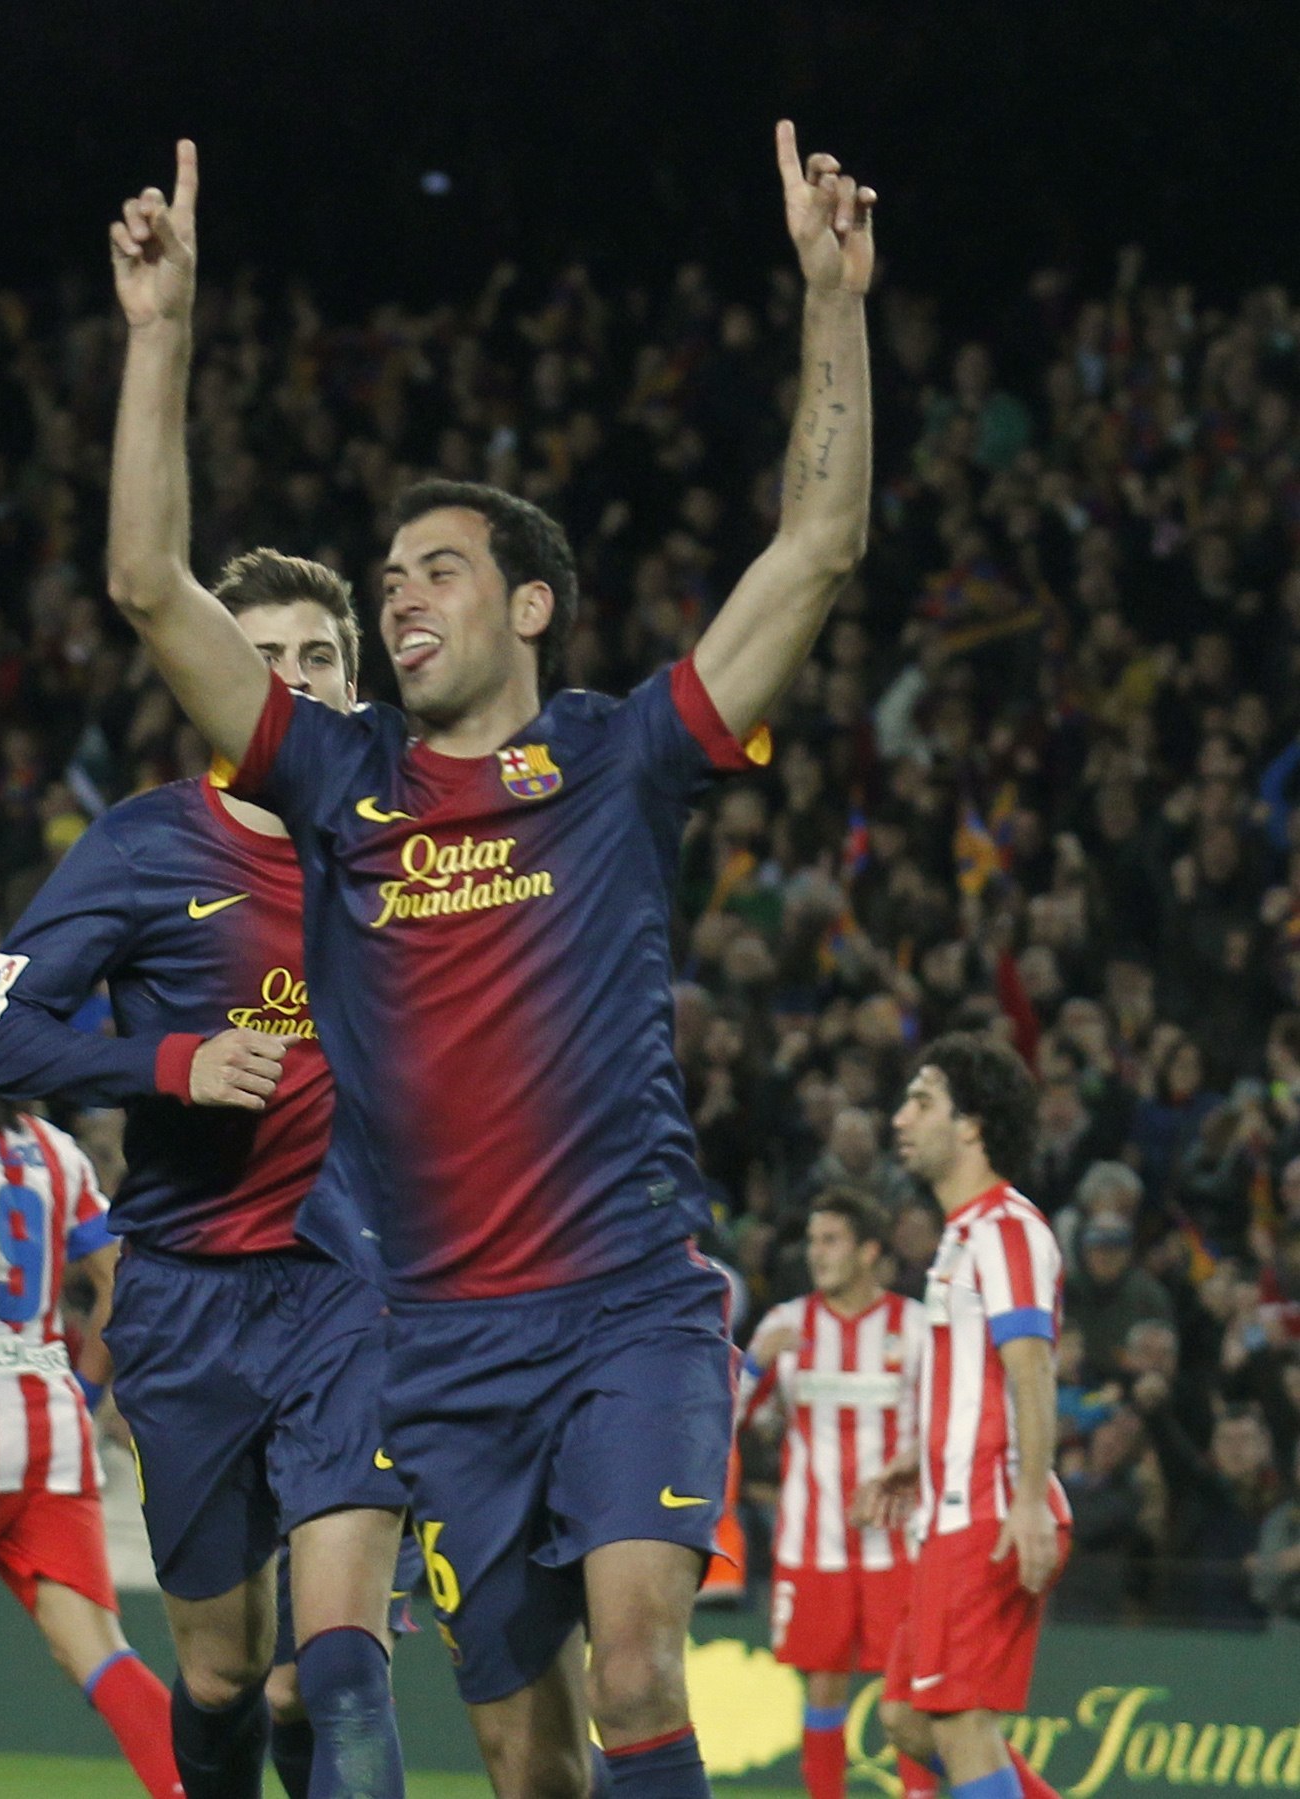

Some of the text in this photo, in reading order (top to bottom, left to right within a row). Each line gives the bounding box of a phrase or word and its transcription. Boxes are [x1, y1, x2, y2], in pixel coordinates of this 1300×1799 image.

[401, 833, 517, 888] Qatar
[369, 866, 555, 929] Foundation
[261, 966, 310, 1016] Qa
[412, 1520, 461, 1614] 6
